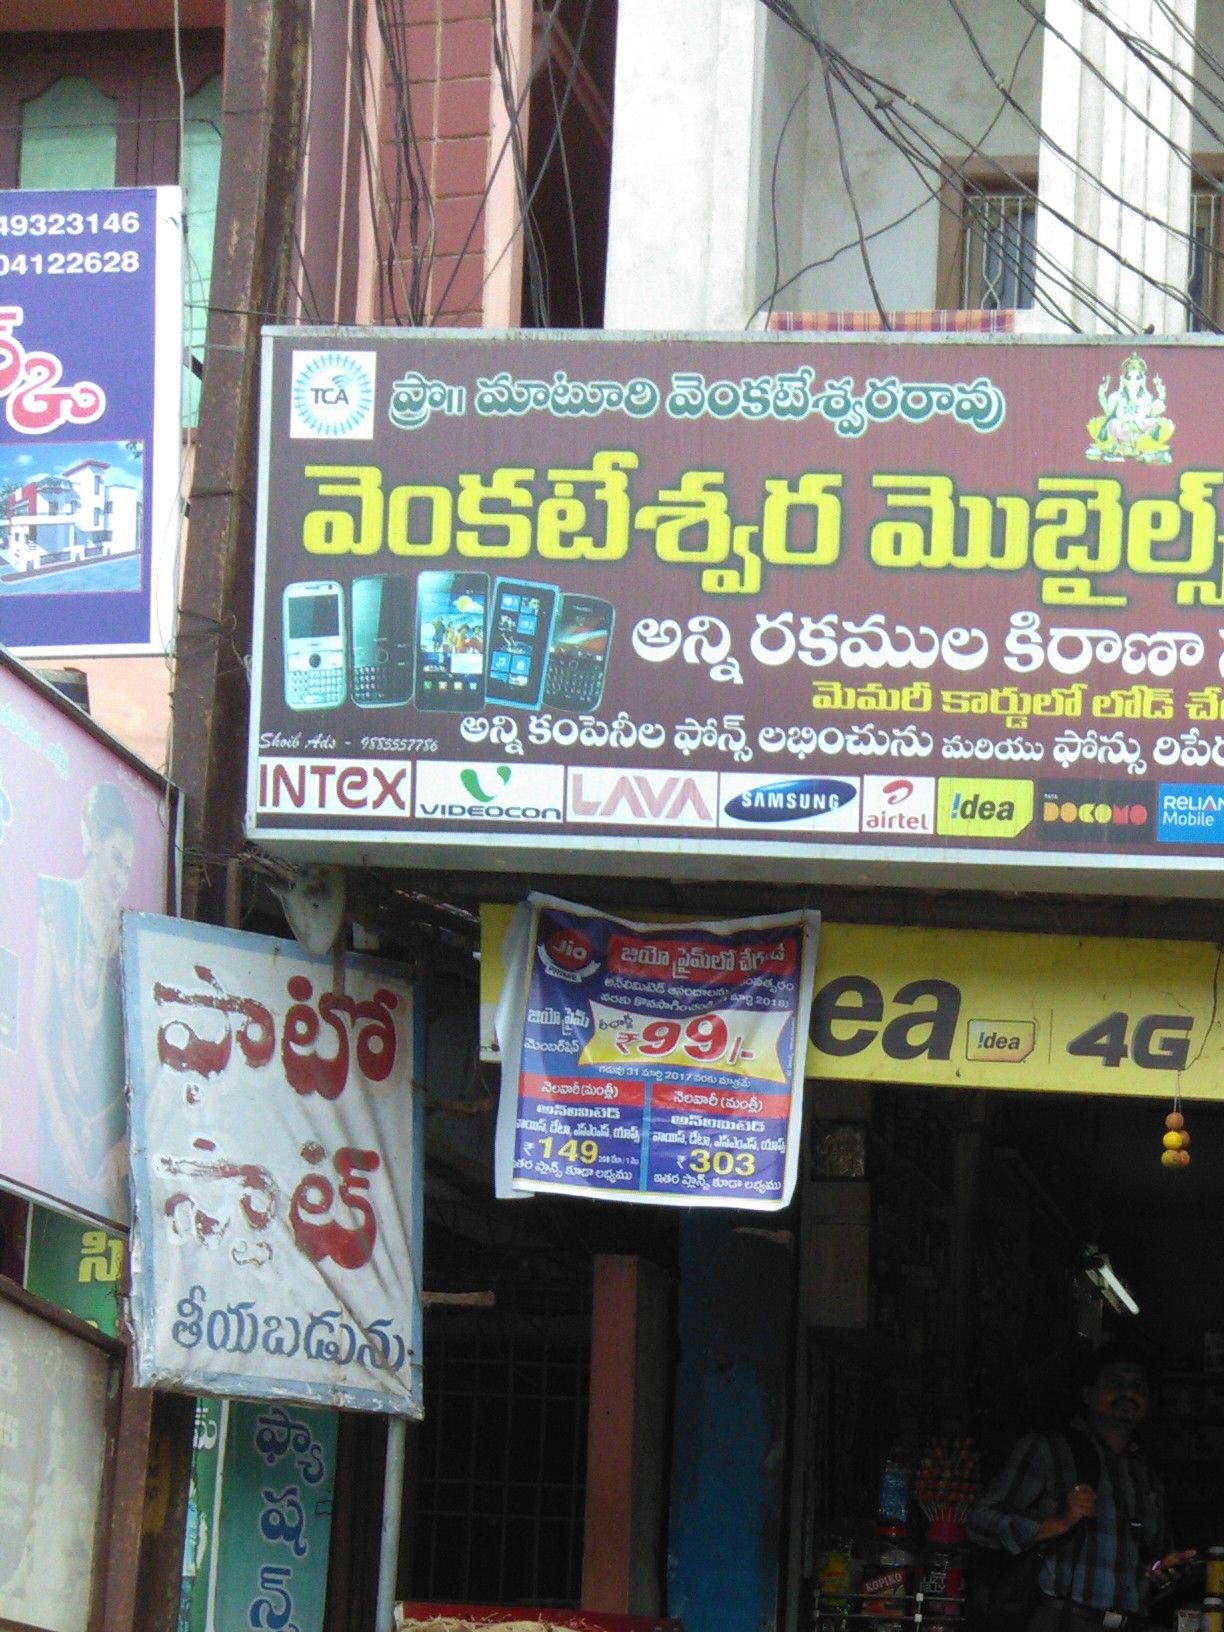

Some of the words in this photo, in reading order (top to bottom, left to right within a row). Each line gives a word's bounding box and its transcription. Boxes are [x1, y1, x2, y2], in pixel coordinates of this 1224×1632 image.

[311, 386, 349, 406] TCA
[476, 370, 661, 419] మాటూరి
[667, 365, 1007, 438] వెంకటేశ్వరరావు
[302, 451, 843, 595] వెంకటేశ్వర
[631, 613, 744, 685] అన్ని
[750, 611, 990, 672] రకముల
[1003, 611, 1205, 677] కిరాణా
[811, 680, 932, 714] మెమరీ
[940, 682, 1089, 730] కార్డులో
[1091, 683, 1175, 720] లోడ్
[304, 732, 337, 750] Ads
[460, 712, 524, 757] అన్ని
[527, 710, 666, 750] కంపెనీల
[674, 714, 754, 764] ఫోన్స్
[757, 721, 935, 761] లభించును
[941, 734, 1046, 762] మరియు
[571, 773, 714, 821] LAVA
[740, 789, 842, 812] SAMSUNG
[865, 812, 930, 832] airtel
[1042, 800, 1149, 827] DOCOMO
[1162, 811, 1215, 828] Mobile
[1065, 1011, 1196, 1072] 4G
[664, 1069, 693, 1082] 2017
[538, 1136, 599, 1165] 149
[688, 1147, 757, 1177] 303
[172, 1285, 408, 1372] తీయబడును
[865, 1572, 904, 1594] KOPIKO
